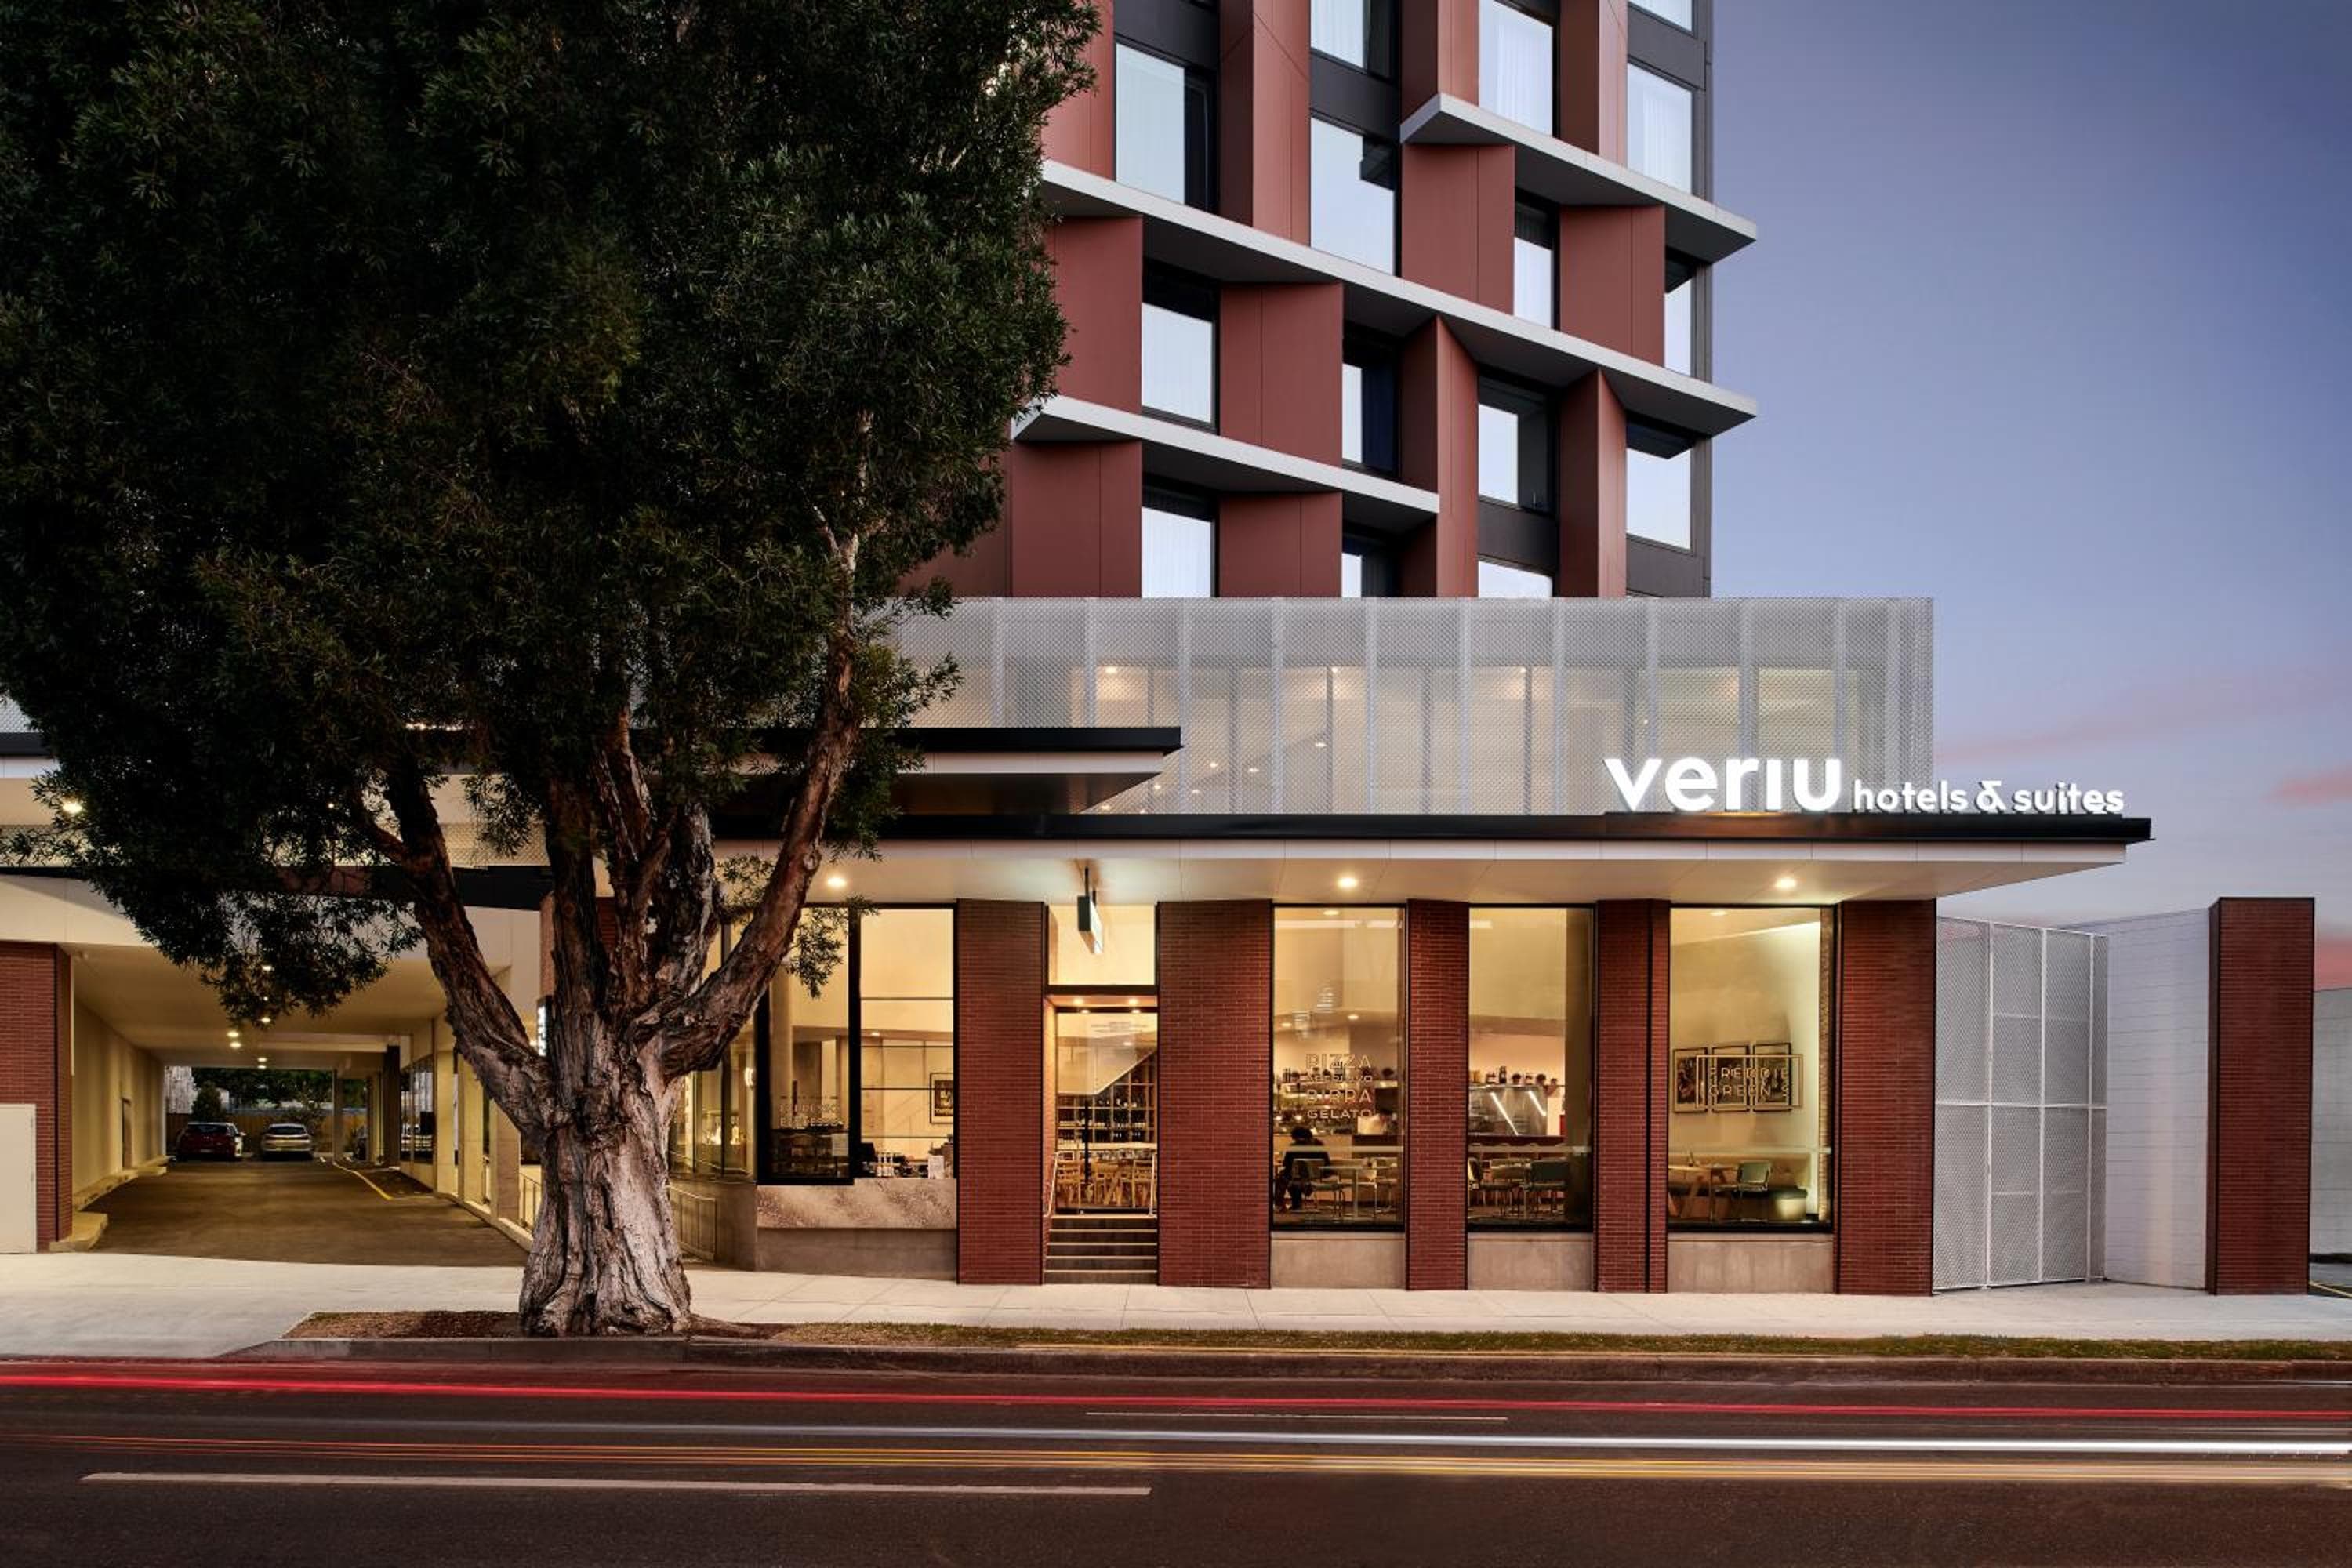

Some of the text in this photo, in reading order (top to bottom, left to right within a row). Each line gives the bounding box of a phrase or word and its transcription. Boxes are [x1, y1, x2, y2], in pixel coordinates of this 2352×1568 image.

[1853, 779, 1968, 812] hotels
[1975, 780, 2006, 813] &
[2014, 781, 2125, 814] suites
[1305, 1053, 1372, 1069] PIZZA
[1709, 1067, 1788, 1080] FREDDIE
[1306, 1089, 1372, 1103] BIRRA
[1709, 1084, 1790, 1098] GREENS
[1307, 1109, 1373, 1119] GELATO
